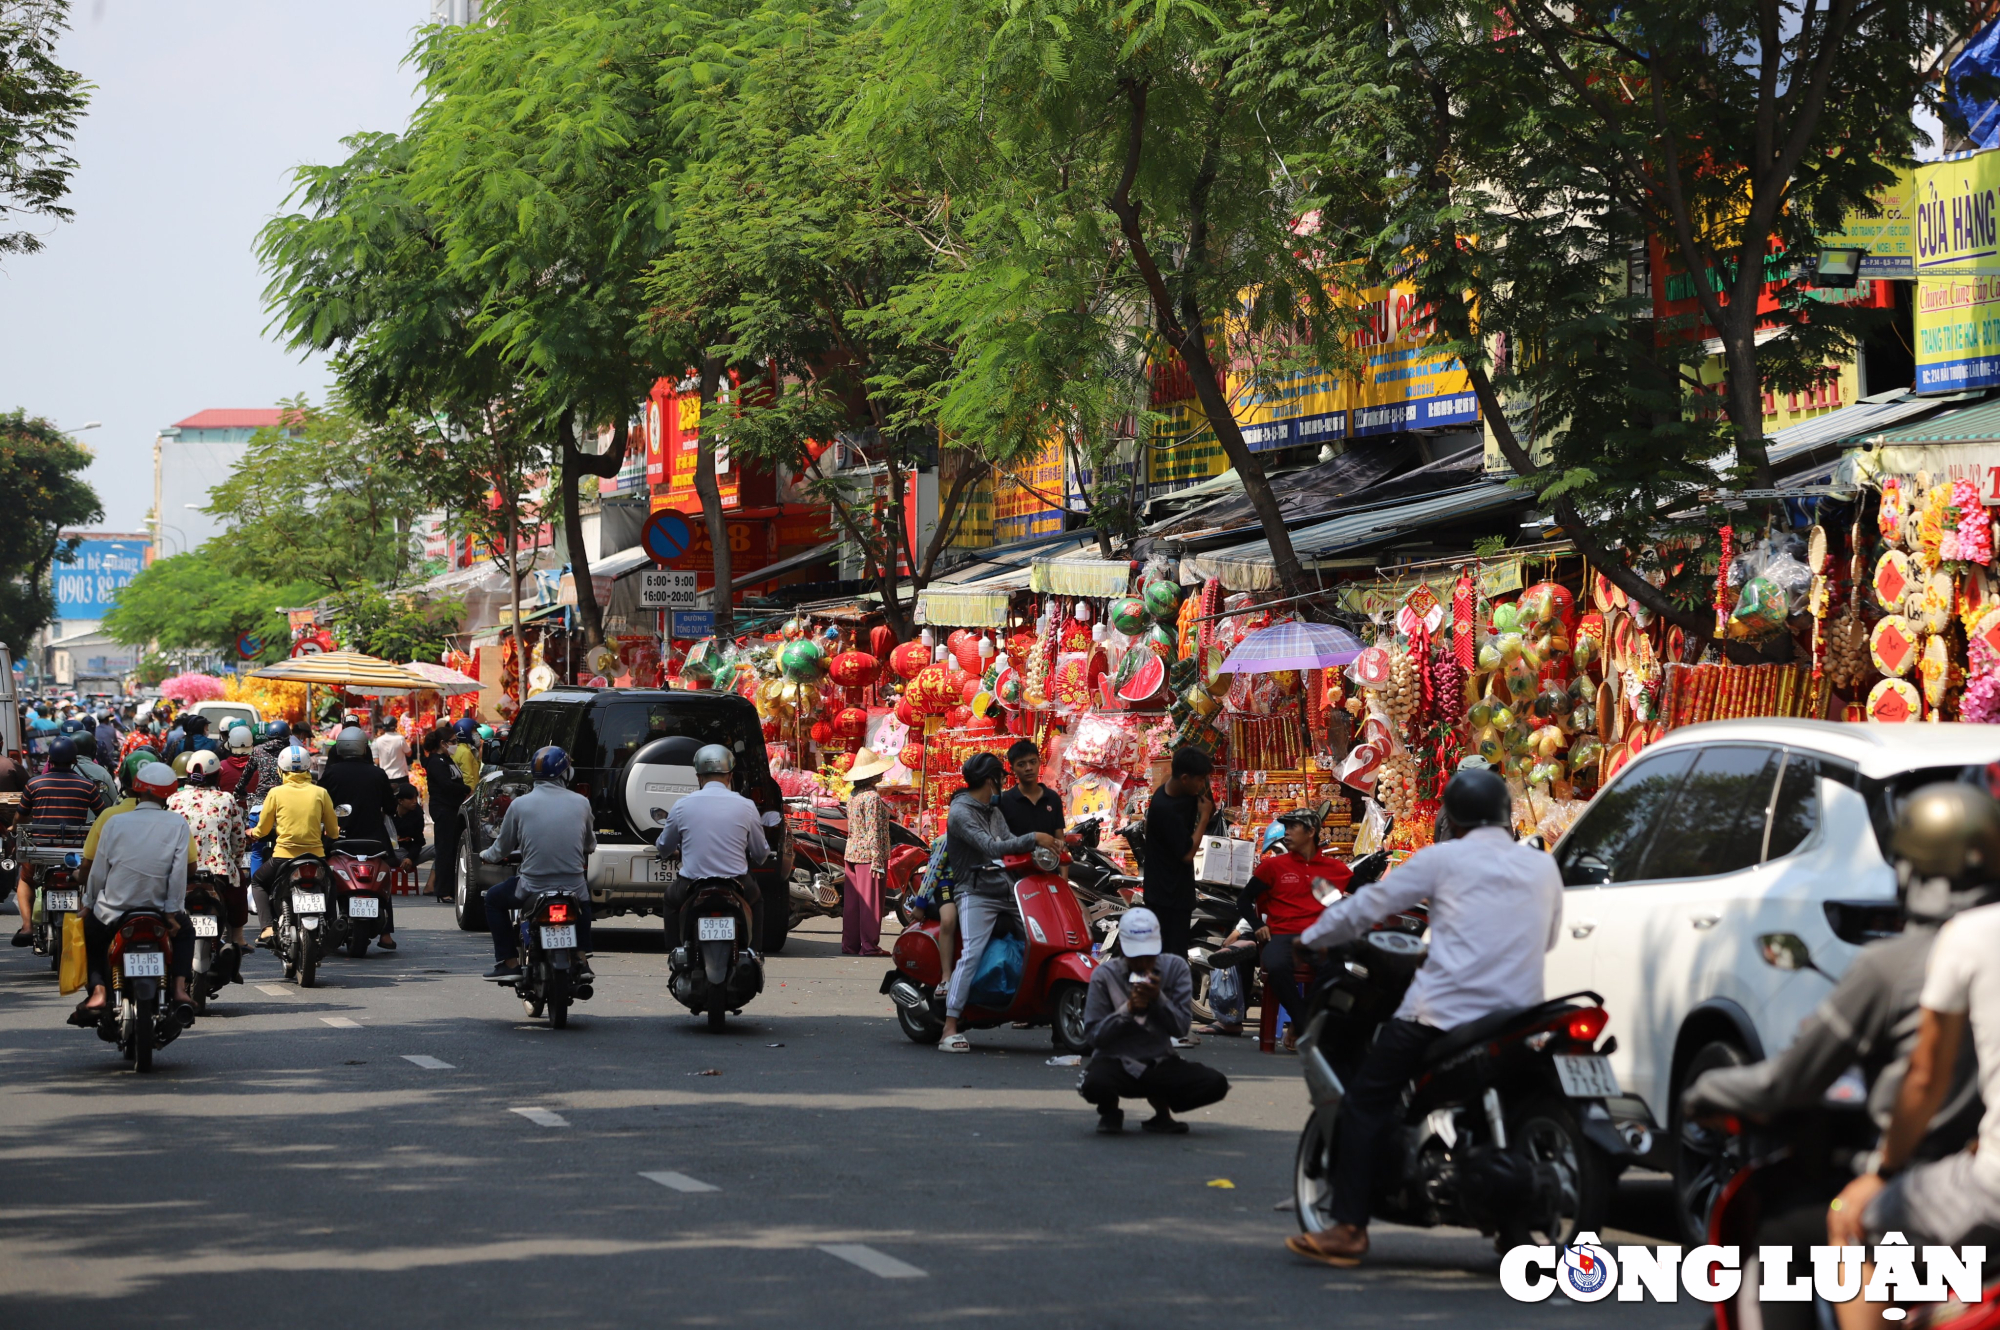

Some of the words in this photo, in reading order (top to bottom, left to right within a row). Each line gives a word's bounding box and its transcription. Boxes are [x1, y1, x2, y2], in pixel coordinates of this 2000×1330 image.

[1918, 181, 1948, 258] CỬA
[1953, 180, 1997, 251] HÀNG
[1877, 243, 1891, 253] NOEL
[1920, 284, 1948, 313] Chuyên
[1950, 281, 1970, 308] Cung
[1921, 326, 1942, 354] TRANG
[1943, 318, 1953, 352] TRÍ
[1954, 324, 1963, 351] XE
[1964, 321, 1979, 349] HOA
[1983, 308, 1992, 346] ĐỒ
[675, 576, 694, 587] 9:00
[58, 576, 93, 603] 0903
[683, 614, 707, 622] ĐƯỜNG
[692, 625, 703, 634] DUY
[52, 901, 74, 909] 5192
[296, 903, 324, 912] 642.54
[353, 900, 374, 908] 59-K2
[351, 908, 377, 917] 068.16
[704, 919, 729, 929] 59-G2
[546, 926, 571, 937] 53-S3
[701, 929, 733, 939] 612.05
[547, 937, 573, 947] 6303
[130, 953, 159, 965] 51-H5
[131, 965, 159, 976] 1918
